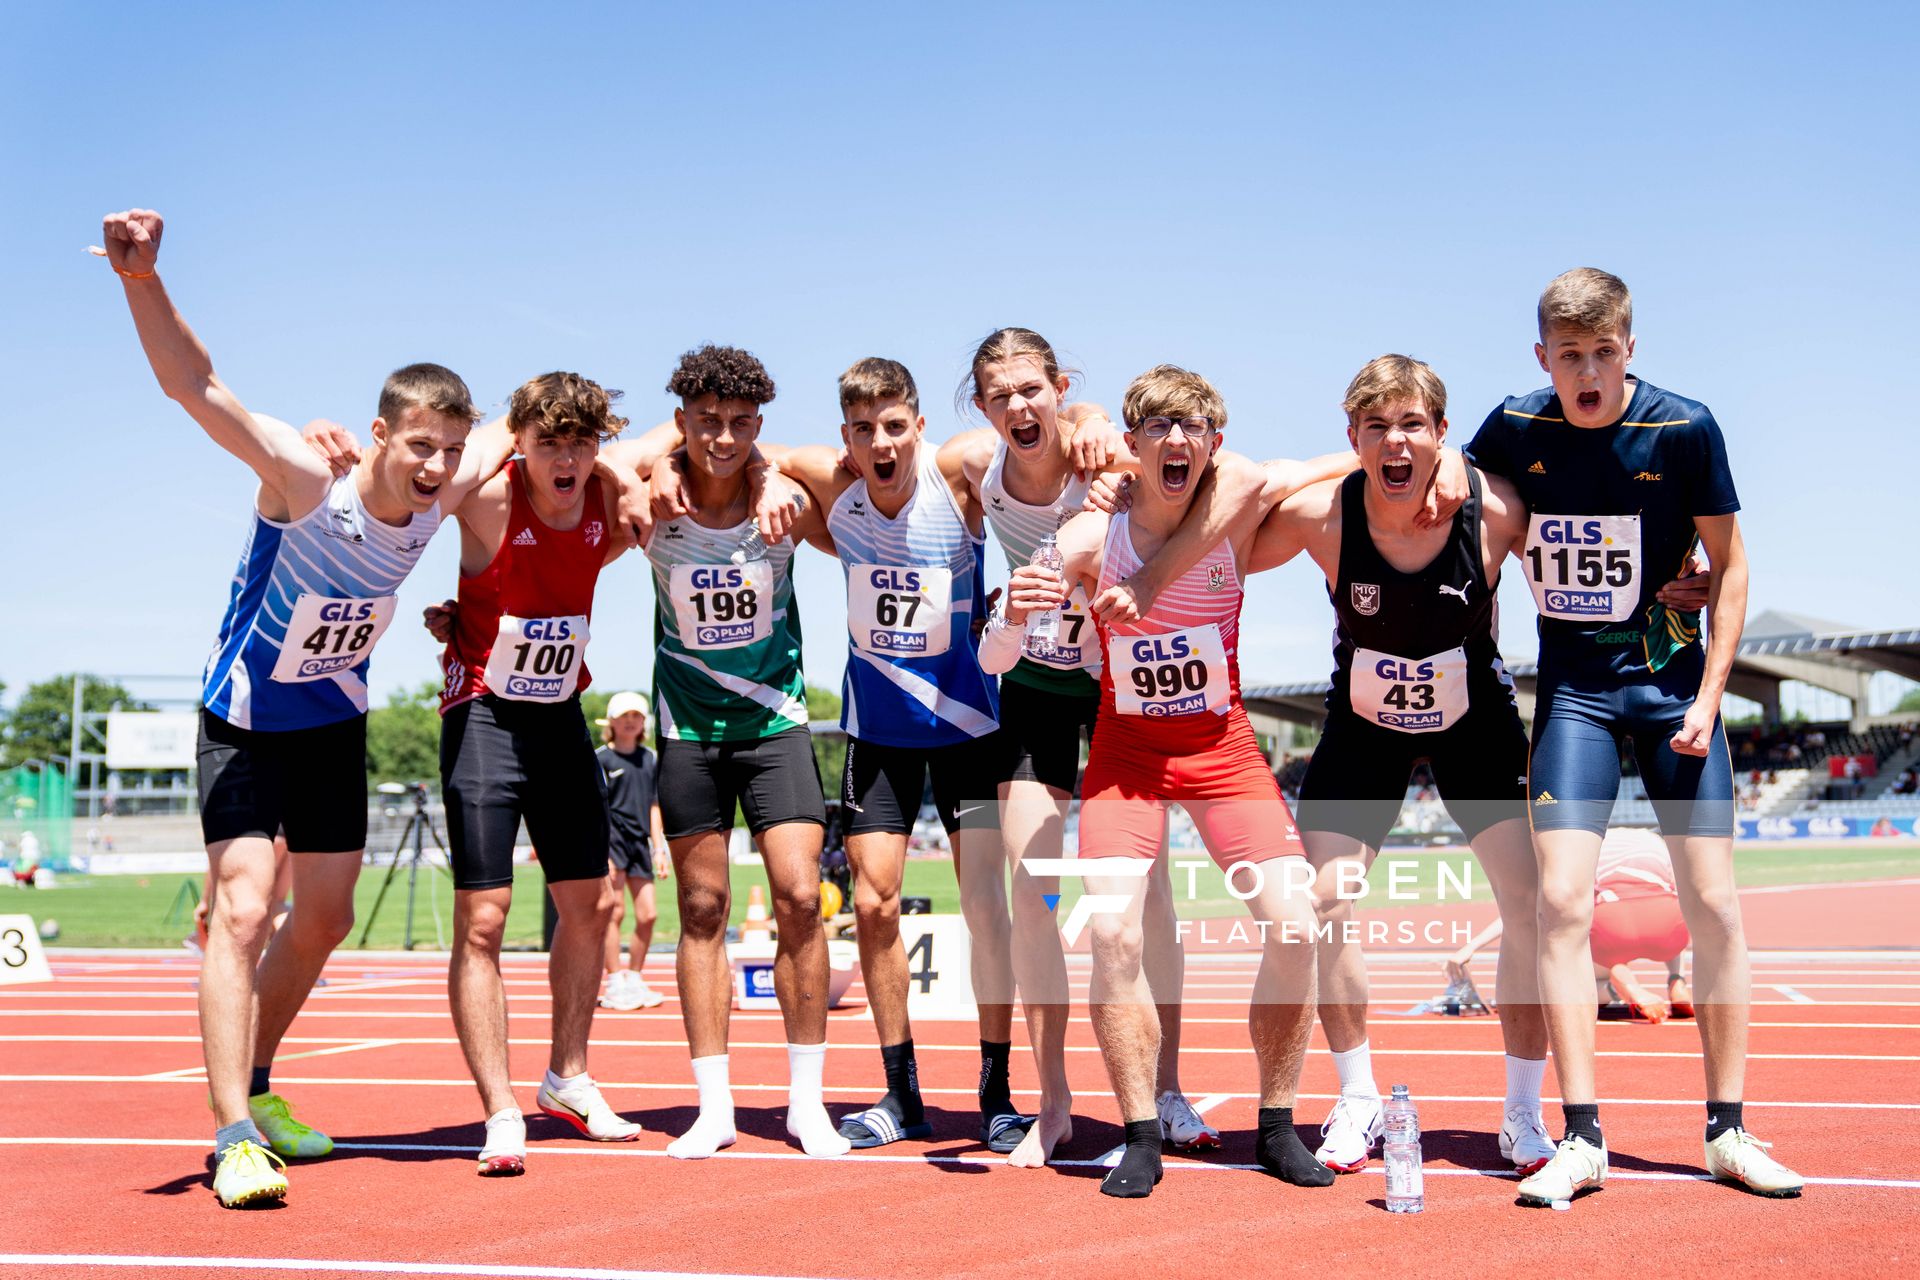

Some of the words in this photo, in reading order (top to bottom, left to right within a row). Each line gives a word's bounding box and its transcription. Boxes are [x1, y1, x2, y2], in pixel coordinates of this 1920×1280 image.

[1526, 546, 1632, 588] 1155
[1355, 585, 1377, 595] MTG
[1571, 595, 1609, 607] PLAN
[689, 589, 758, 622] 198
[876, 593, 921, 628] 67
[302, 623, 374, 655] 418
[720, 625, 753, 637] PLAN
[892, 634, 925, 646] PLAN
[322, 656, 355, 669] PLAN
[514, 642, 575, 675] 100
[531, 681, 561, 692] PLAN
[1131, 659, 1208, 698] 990
[1168, 697, 1204, 713] PLAN
[1383, 684, 1435, 710] 43
[1404, 714, 1440, 724] PLAN
[3, 929, 27, 967] 3
[908, 933, 939, 993] 4
